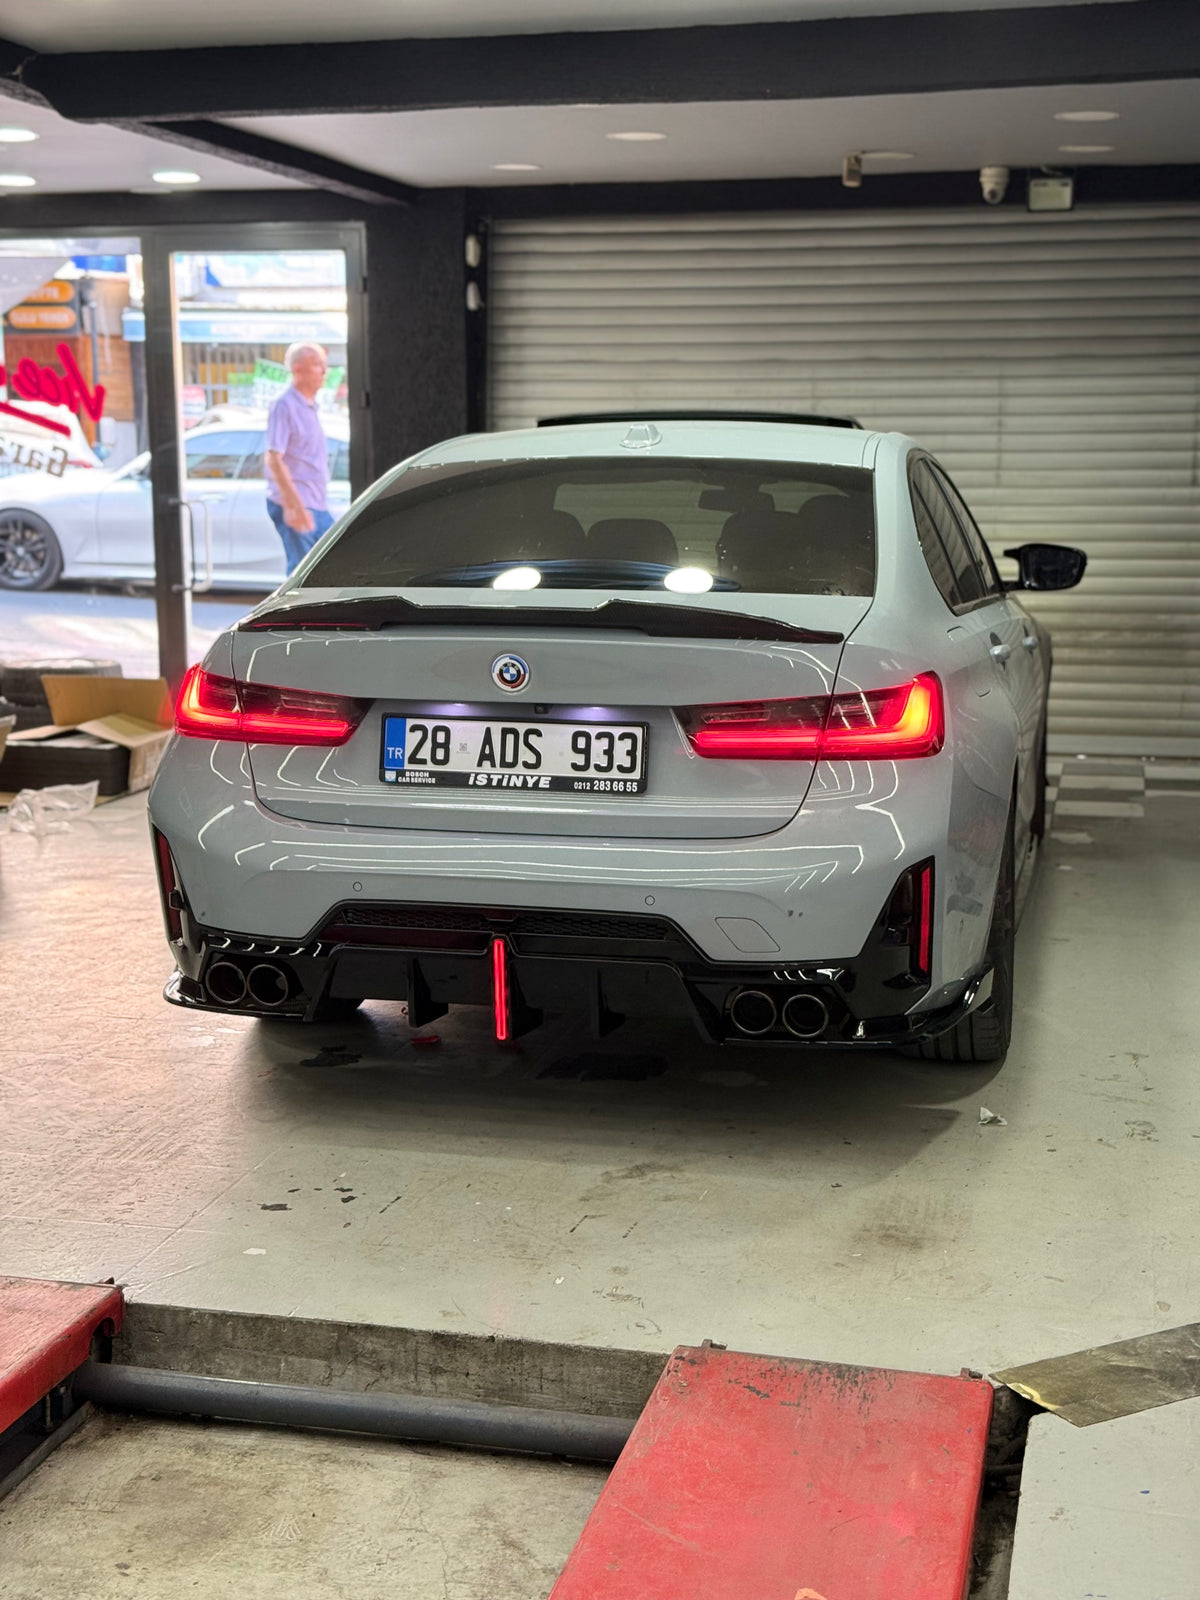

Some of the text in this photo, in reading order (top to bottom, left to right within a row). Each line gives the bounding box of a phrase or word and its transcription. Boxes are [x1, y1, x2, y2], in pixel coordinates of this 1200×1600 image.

[387, 747, 403, 759] TR
[408, 724, 638, 773] 28 ADS 933
[573, 780, 638, 792] 0212 283 66 55
